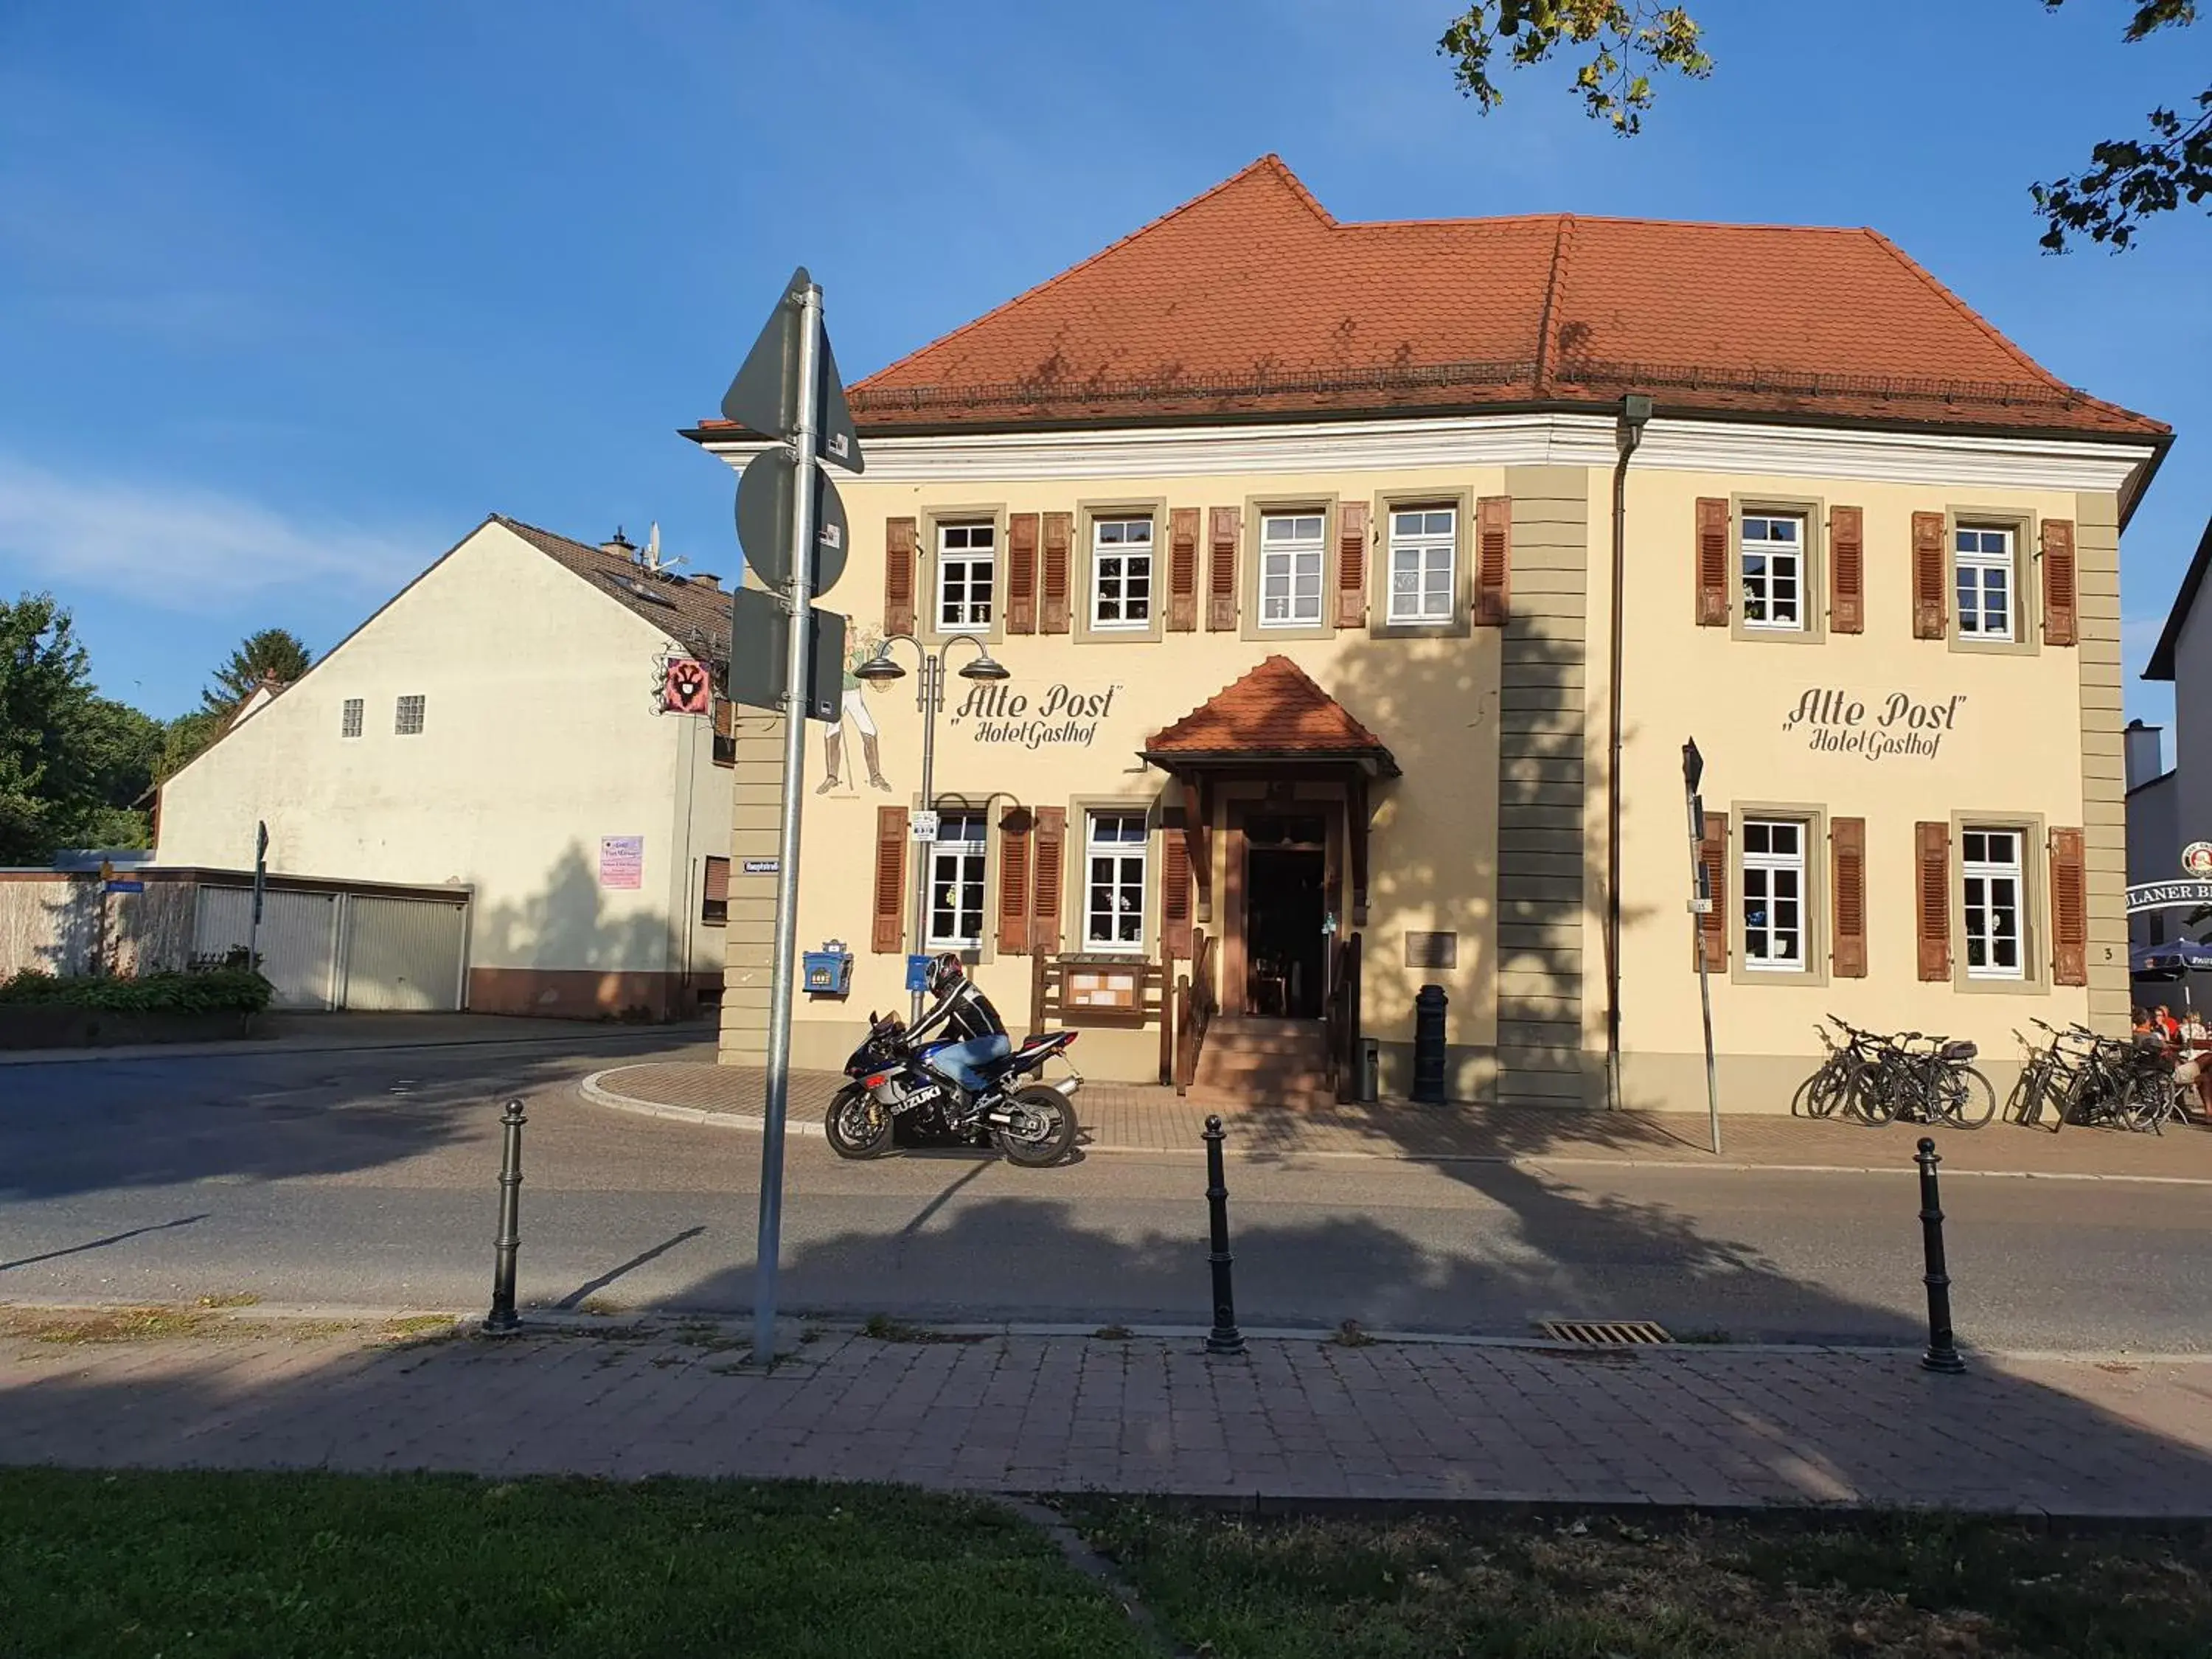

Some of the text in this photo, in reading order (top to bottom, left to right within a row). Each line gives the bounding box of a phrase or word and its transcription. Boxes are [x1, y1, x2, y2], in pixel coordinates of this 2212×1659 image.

[2197, 886, 2212, 897] B
[2104, 947, 2112, 960] 3
[890, 1085, 942, 1116] SUZUKI
